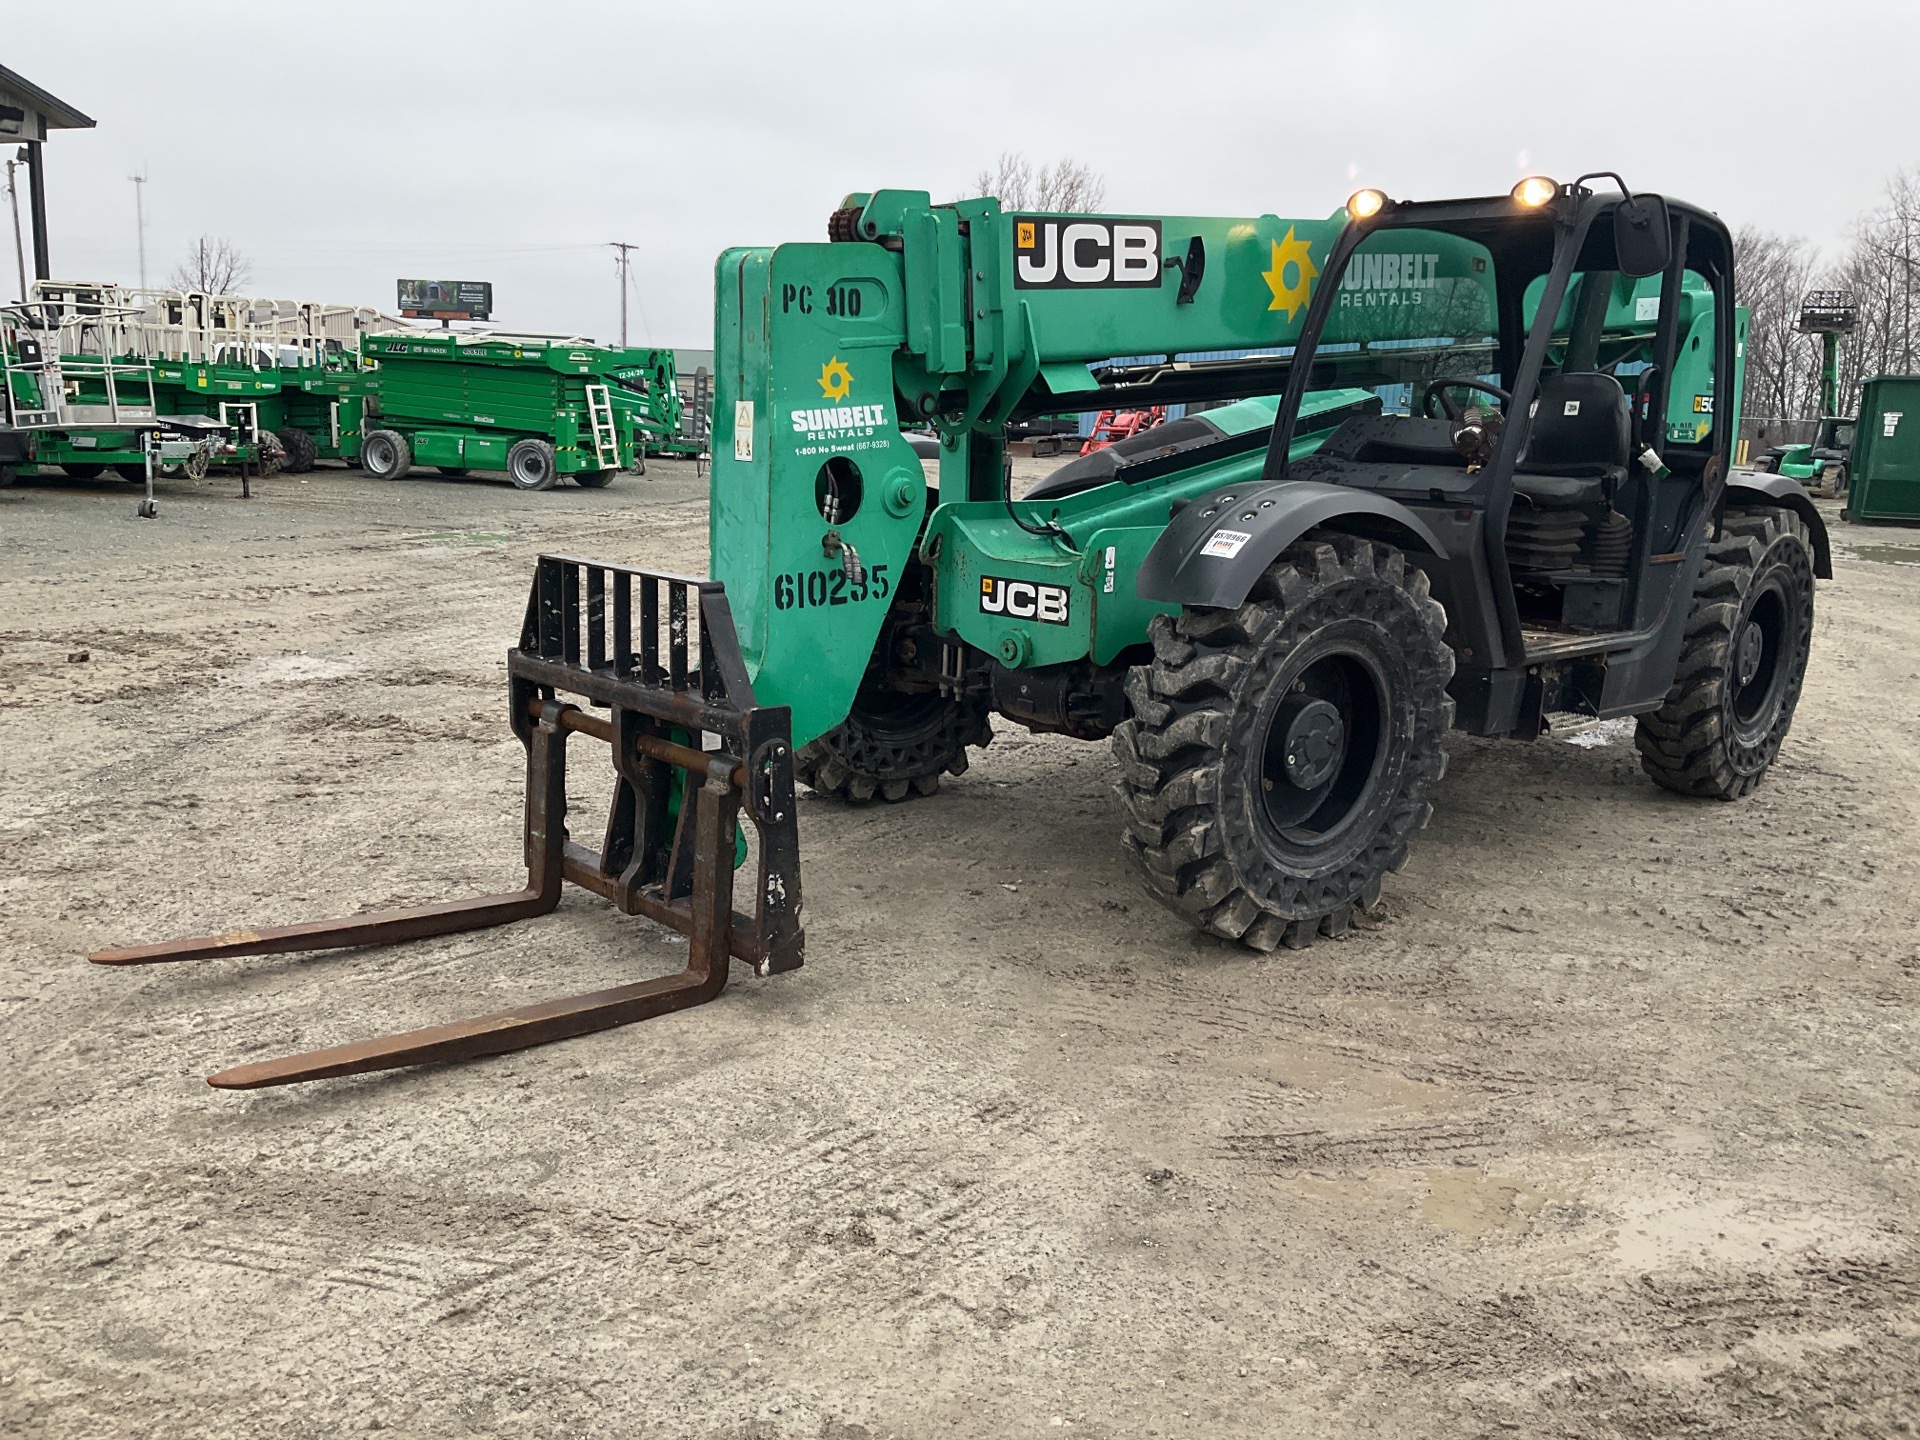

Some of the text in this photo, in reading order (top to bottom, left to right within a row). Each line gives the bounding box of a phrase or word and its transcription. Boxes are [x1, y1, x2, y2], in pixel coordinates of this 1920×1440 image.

[1018, 223, 1158, 283] JCB
[1324, 254, 1439, 290] UNBELT
[782, 284, 861, 317] PC 310
[1340, 292, 1422, 307] RENTALS
[386, 343, 408, 354] JLG
[791, 405, 884, 432] SUNBELT
[795, 446, 817, 456] 1-800
[831, 443, 855, 453] Sweat
[856, 440, 890, 451] (667-9328)
[807, 427, 874, 441] RENTALS
[775, 565, 889, 610] 610235
[981, 580, 1068, 622] JCB
